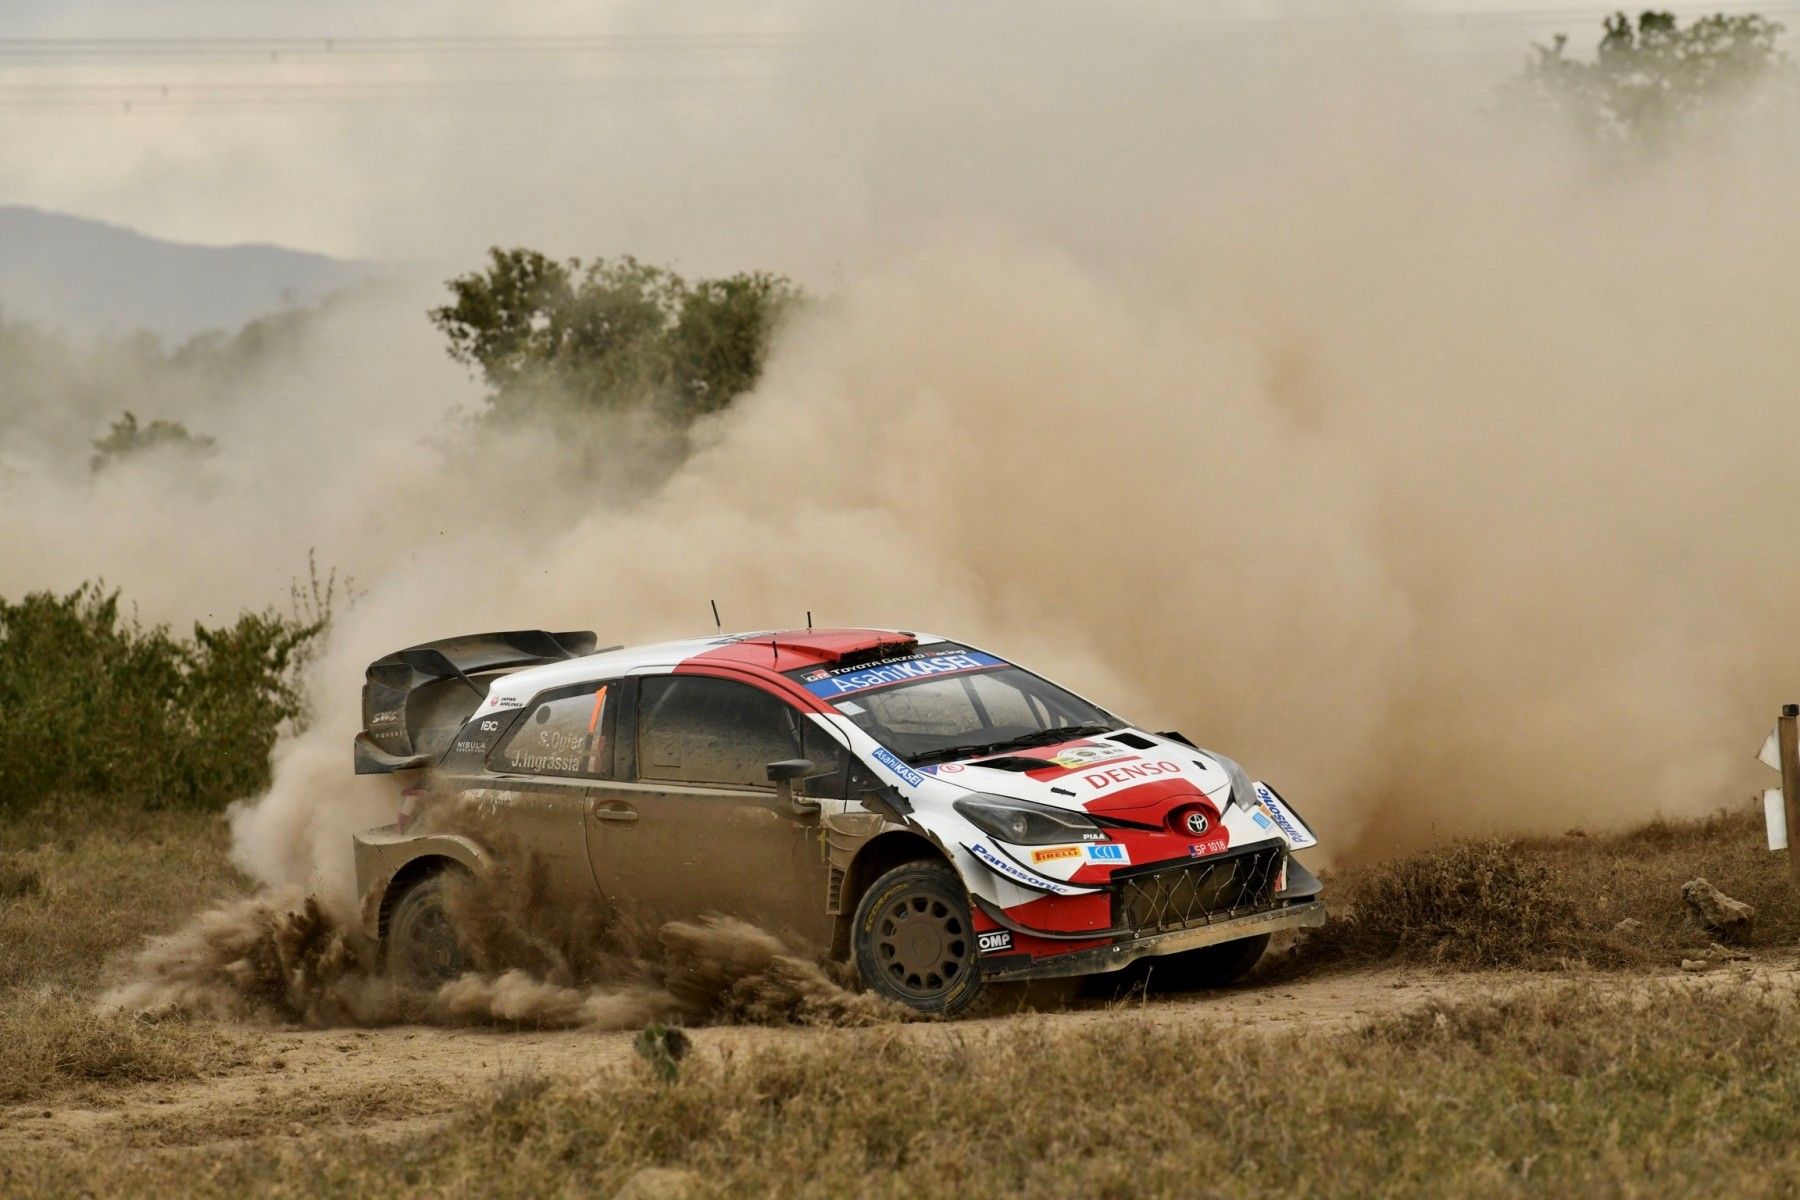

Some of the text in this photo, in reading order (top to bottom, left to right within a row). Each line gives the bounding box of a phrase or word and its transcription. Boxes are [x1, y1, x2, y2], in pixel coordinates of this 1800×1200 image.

[830, 661, 881, 675] TOYOTA
[882, 653, 926, 664] GAZOO
[831, 655, 983, 692] AsahiKASEI
[874, 748, 921, 785] AsahiKASEI
[1083, 761, 1182, 789] DENSO
[1257, 787, 1309, 844] Panasonic
[1035, 847, 1078, 861] PIRELLI
[1194, 845, 1207, 855] SP
[971, 843, 1068, 893] Panasonic
[979, 933, 1011, 949] OMP
